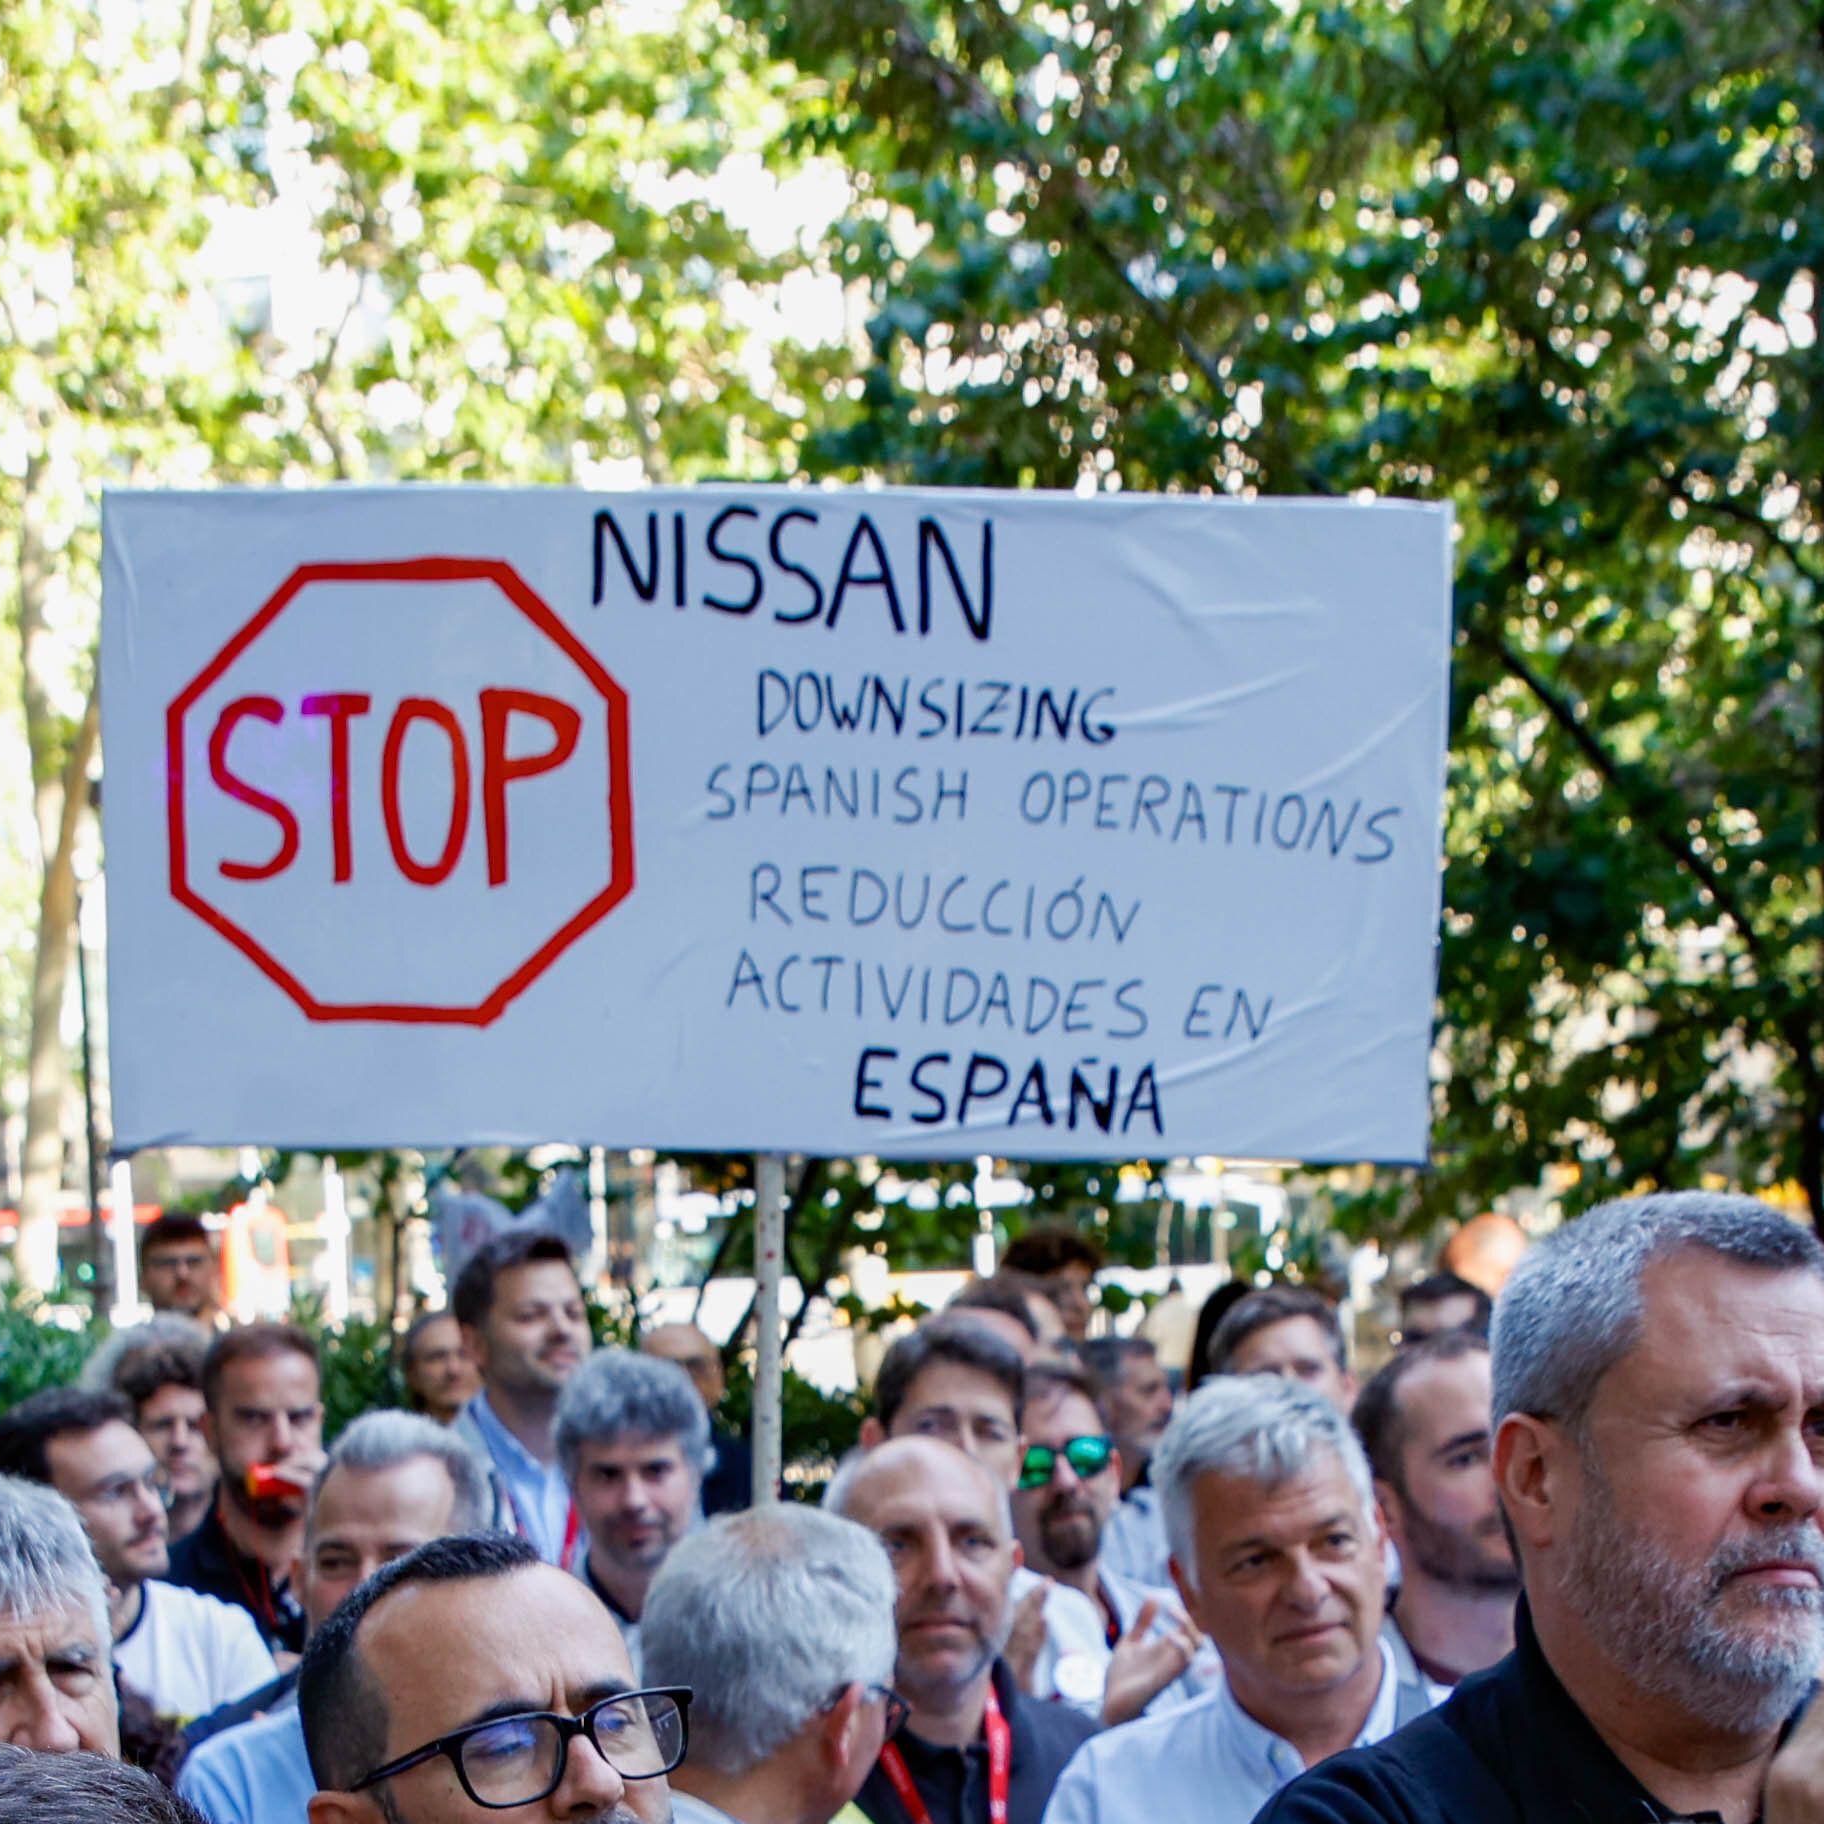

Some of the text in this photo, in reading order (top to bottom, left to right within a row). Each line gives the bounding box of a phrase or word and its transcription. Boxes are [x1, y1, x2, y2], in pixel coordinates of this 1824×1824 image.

[591, 505, 995, 642] NISSAN
[756, 668, 1118, 747] DOWNSIZING
[207, 685, 582, 886] STOP
[705, 763, 1403, 867] SPANISH OPERATIONS
[747, 861, 1141, 945] REDUCCIÓN
[726, 948, 1276, 1044] ACTIVIDADES EN
[852, 1046, 1167, 1136] ESPAÑA
